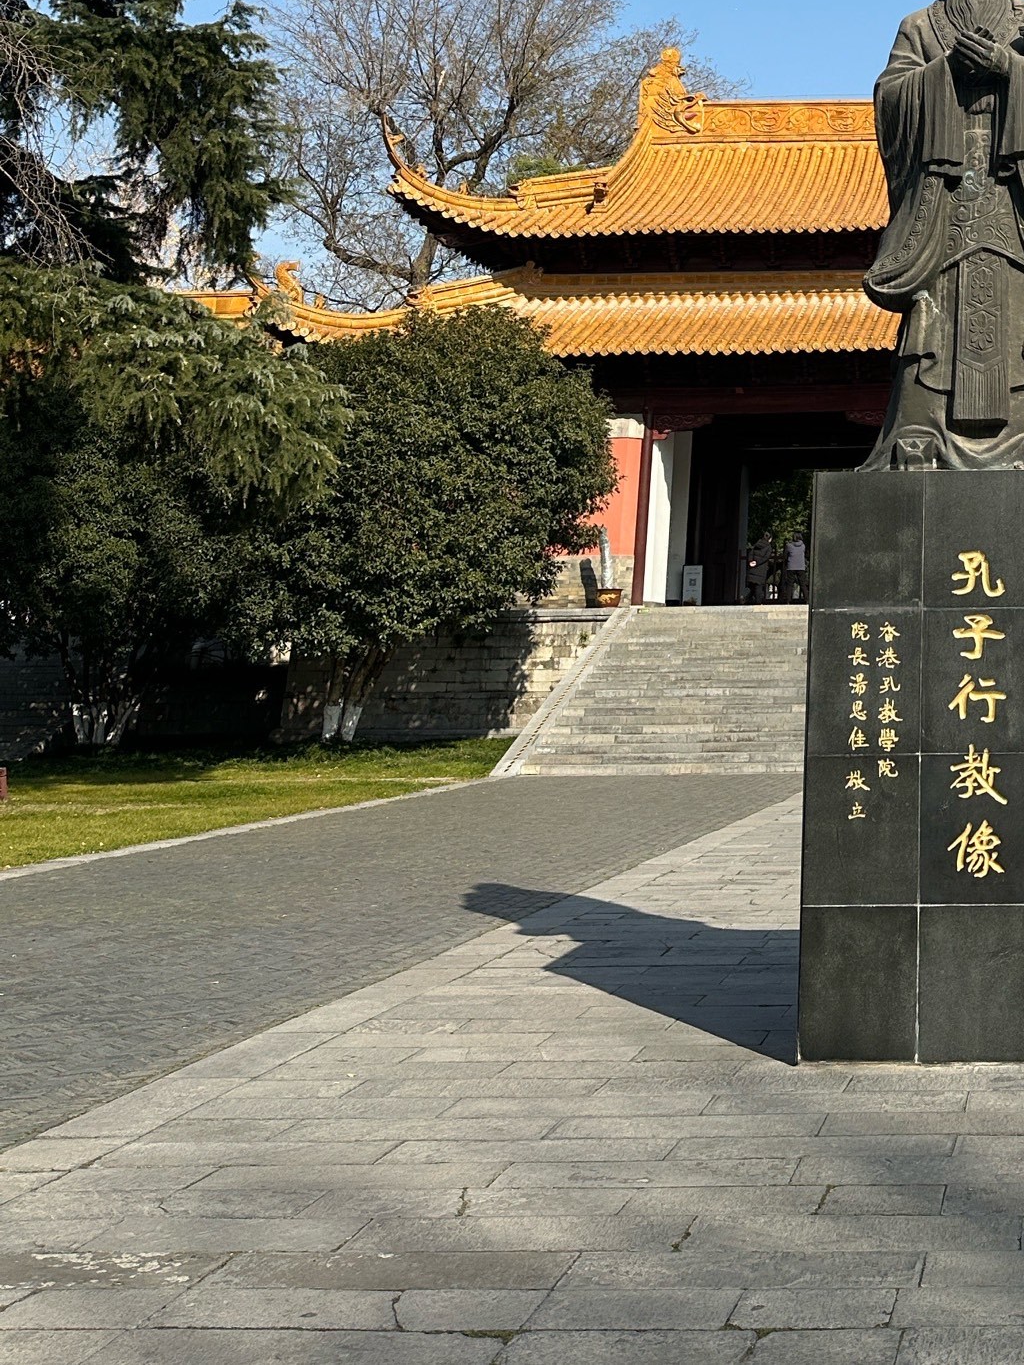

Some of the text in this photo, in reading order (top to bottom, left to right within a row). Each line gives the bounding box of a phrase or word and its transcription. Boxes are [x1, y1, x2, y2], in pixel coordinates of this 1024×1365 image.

[876, 621, 903, 777] 香港孔教學院
[949, 550, 1007, 877] 孔子行教像
